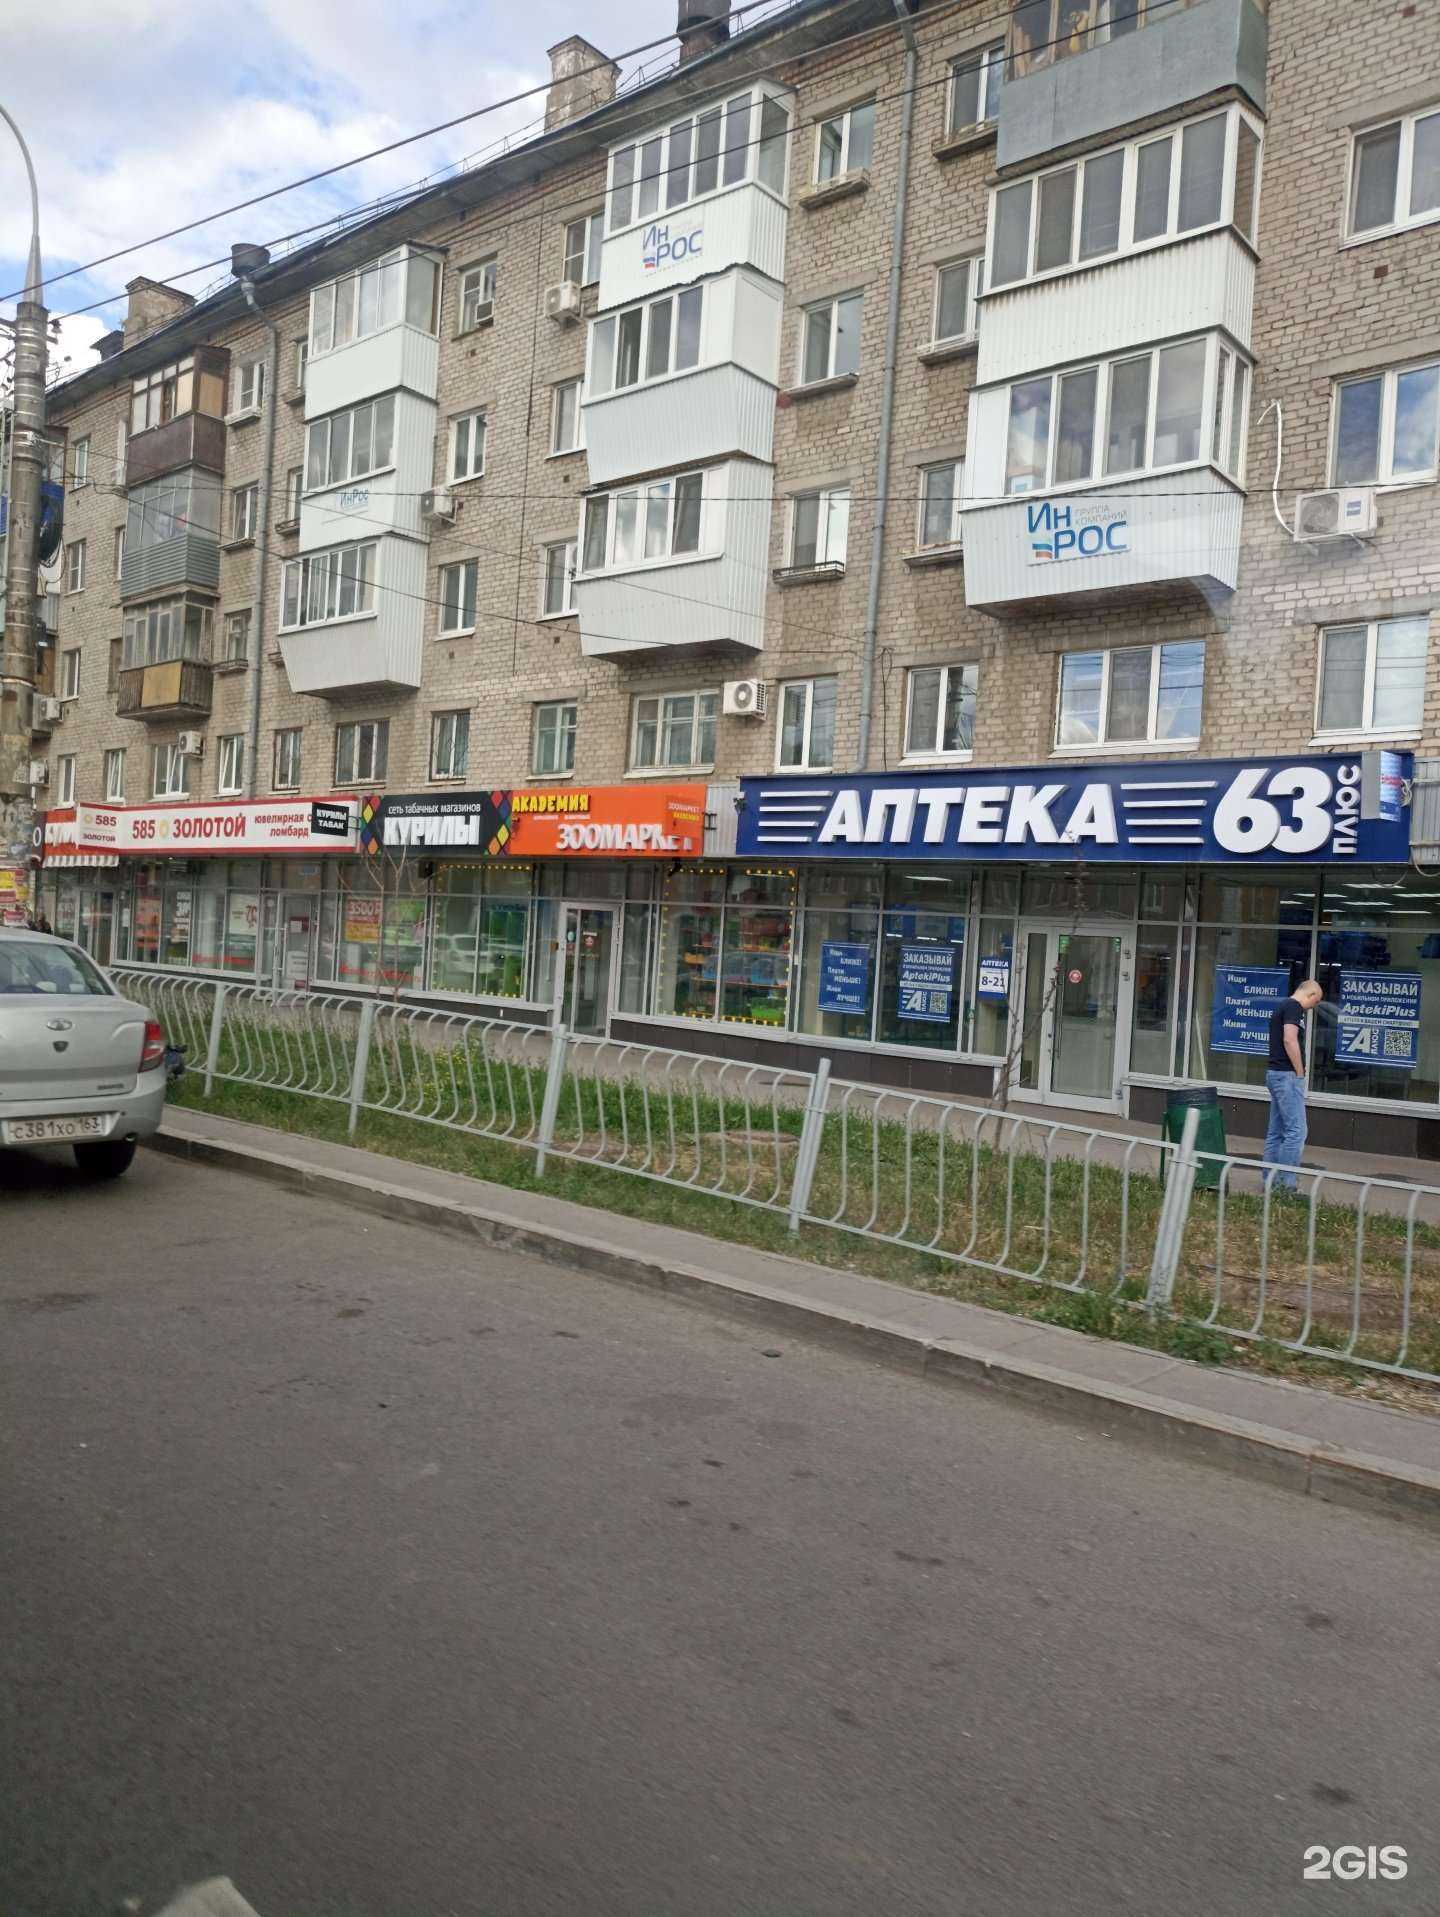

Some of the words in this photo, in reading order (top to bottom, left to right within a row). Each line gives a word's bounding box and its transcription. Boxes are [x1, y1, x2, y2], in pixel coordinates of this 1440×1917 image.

[656, 229, 703, 268] РОС
[1054, 520, 1127, 559] РОС
[388, 804, 404, 815] сеть
[405, 802, 439, 814] табачных
[440, 803, 481, 813] магазинов
[512, 794, 590, 813] АКАДЕМИЯ
[817, 784, 1119, 843] АПТЕКА
[1213, 766, 1334, 854] 63
[1332, 764, 1361, 854] ПЛЮС
[95, 815, 117, 827] 585
[254, 813, 304, 824] ювелирная
[318, 819, 344, 830] ТАБАК
[132, 819, 156, 839] 585
[172, 812, 246, 838] ЗОЛОТОЙ
[270, 825, 309, 838] ломбард
[383, 815, 480, 846] КУРИЛЫ
[903, 952, 952, 966] ЗАКАЗЫВАЙ
[981, 959, 1009, 967] АПТЕКА
[902, 970, 951, 982] AptekiPlus
[981, 976, 1005, 987] 8-21
[1228, 974, 1247, 983] Ищи
[1244, 986, 1278, 996] БЛИЖЕ!
[1342, 980, 1418, 996] ЗАКАЗЫВАЙ
[1225, 997, 1251, 1006] Плати
[1343, 1002, 1416, 1017] AptekiPlus
